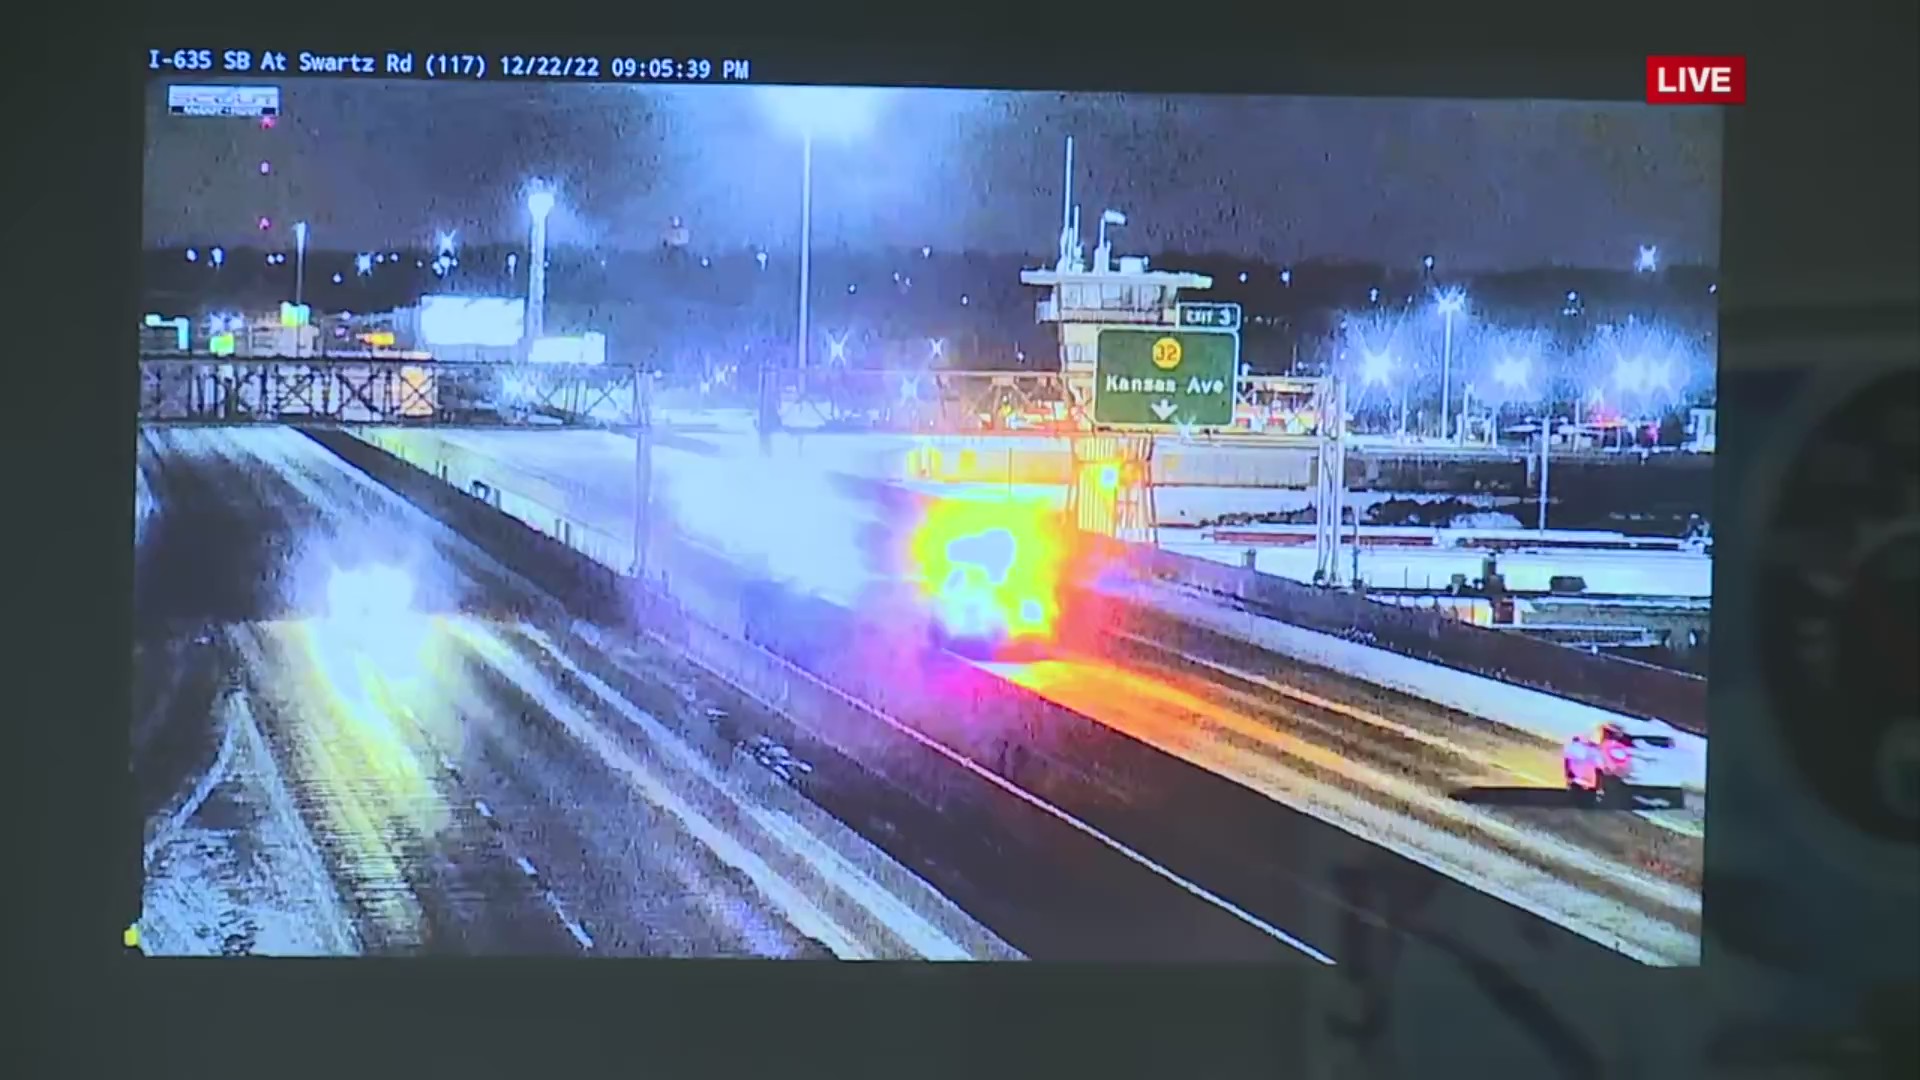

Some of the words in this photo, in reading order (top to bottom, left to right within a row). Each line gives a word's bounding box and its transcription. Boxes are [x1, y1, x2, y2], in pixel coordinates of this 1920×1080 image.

[149, 49, 212, 69] I-635
[223, 50, 251, 70] SB
[260, 51, 287, 71] At
[300, 52, 375, 73] Swartz
[386, 53, 413, 73] Rd
[425, 53, 485, 78] (117)
[500, 55, 600, 76] 12/22/22
[611, 58, 711, 79] 09:05:39
[722, 59, 750, 80] PM
[1155, 343, 1178, 362] 32
[1106, 374, 1177, 393] Kansas
[1186, 375, 1225, 394] Ave
